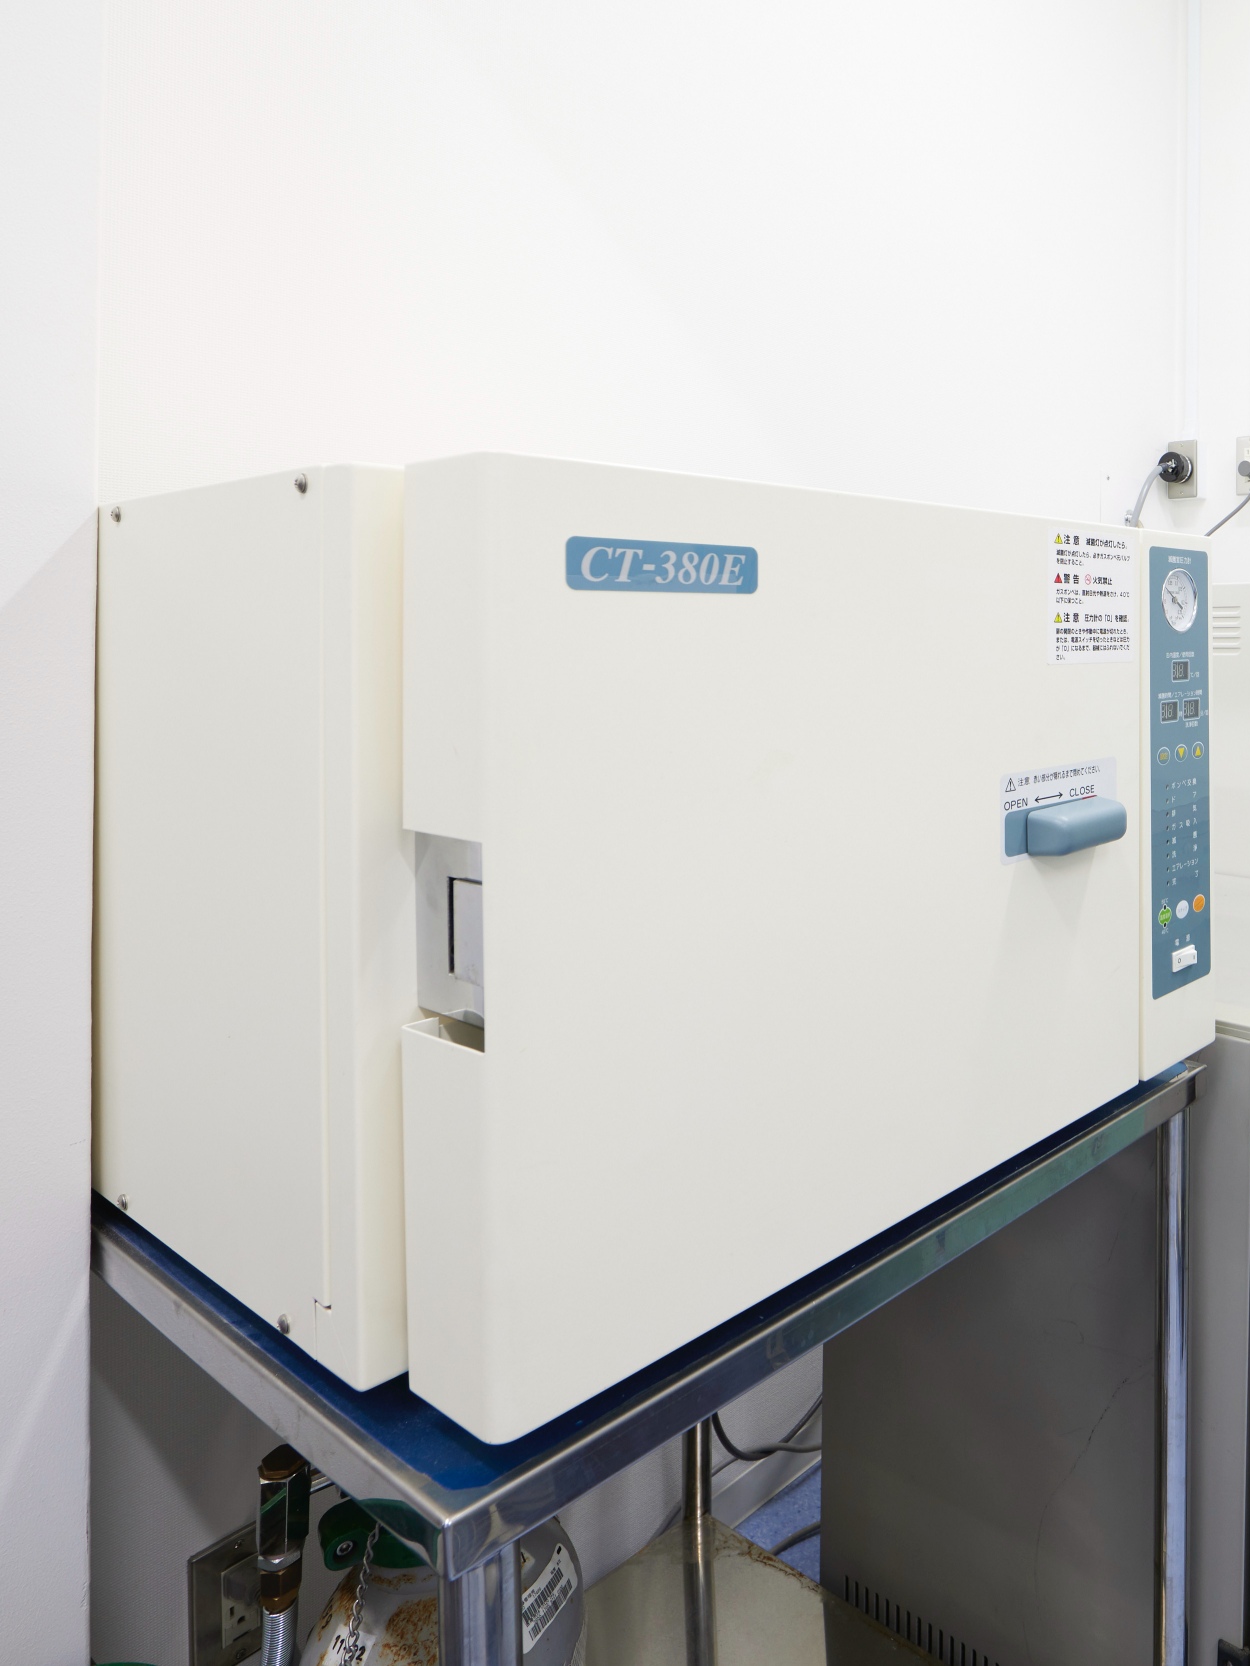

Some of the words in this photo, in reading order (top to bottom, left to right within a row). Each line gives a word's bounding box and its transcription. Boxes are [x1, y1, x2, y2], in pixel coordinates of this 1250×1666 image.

[1063, 534, 1080, 545] 注意
[580, 546, 746, 586] CT-380E
[1063, 612, 1080, 623] 注意
[1069, 784, 1095, 797] CLOSE
[1003, 797, 1028, 811] OPEN
